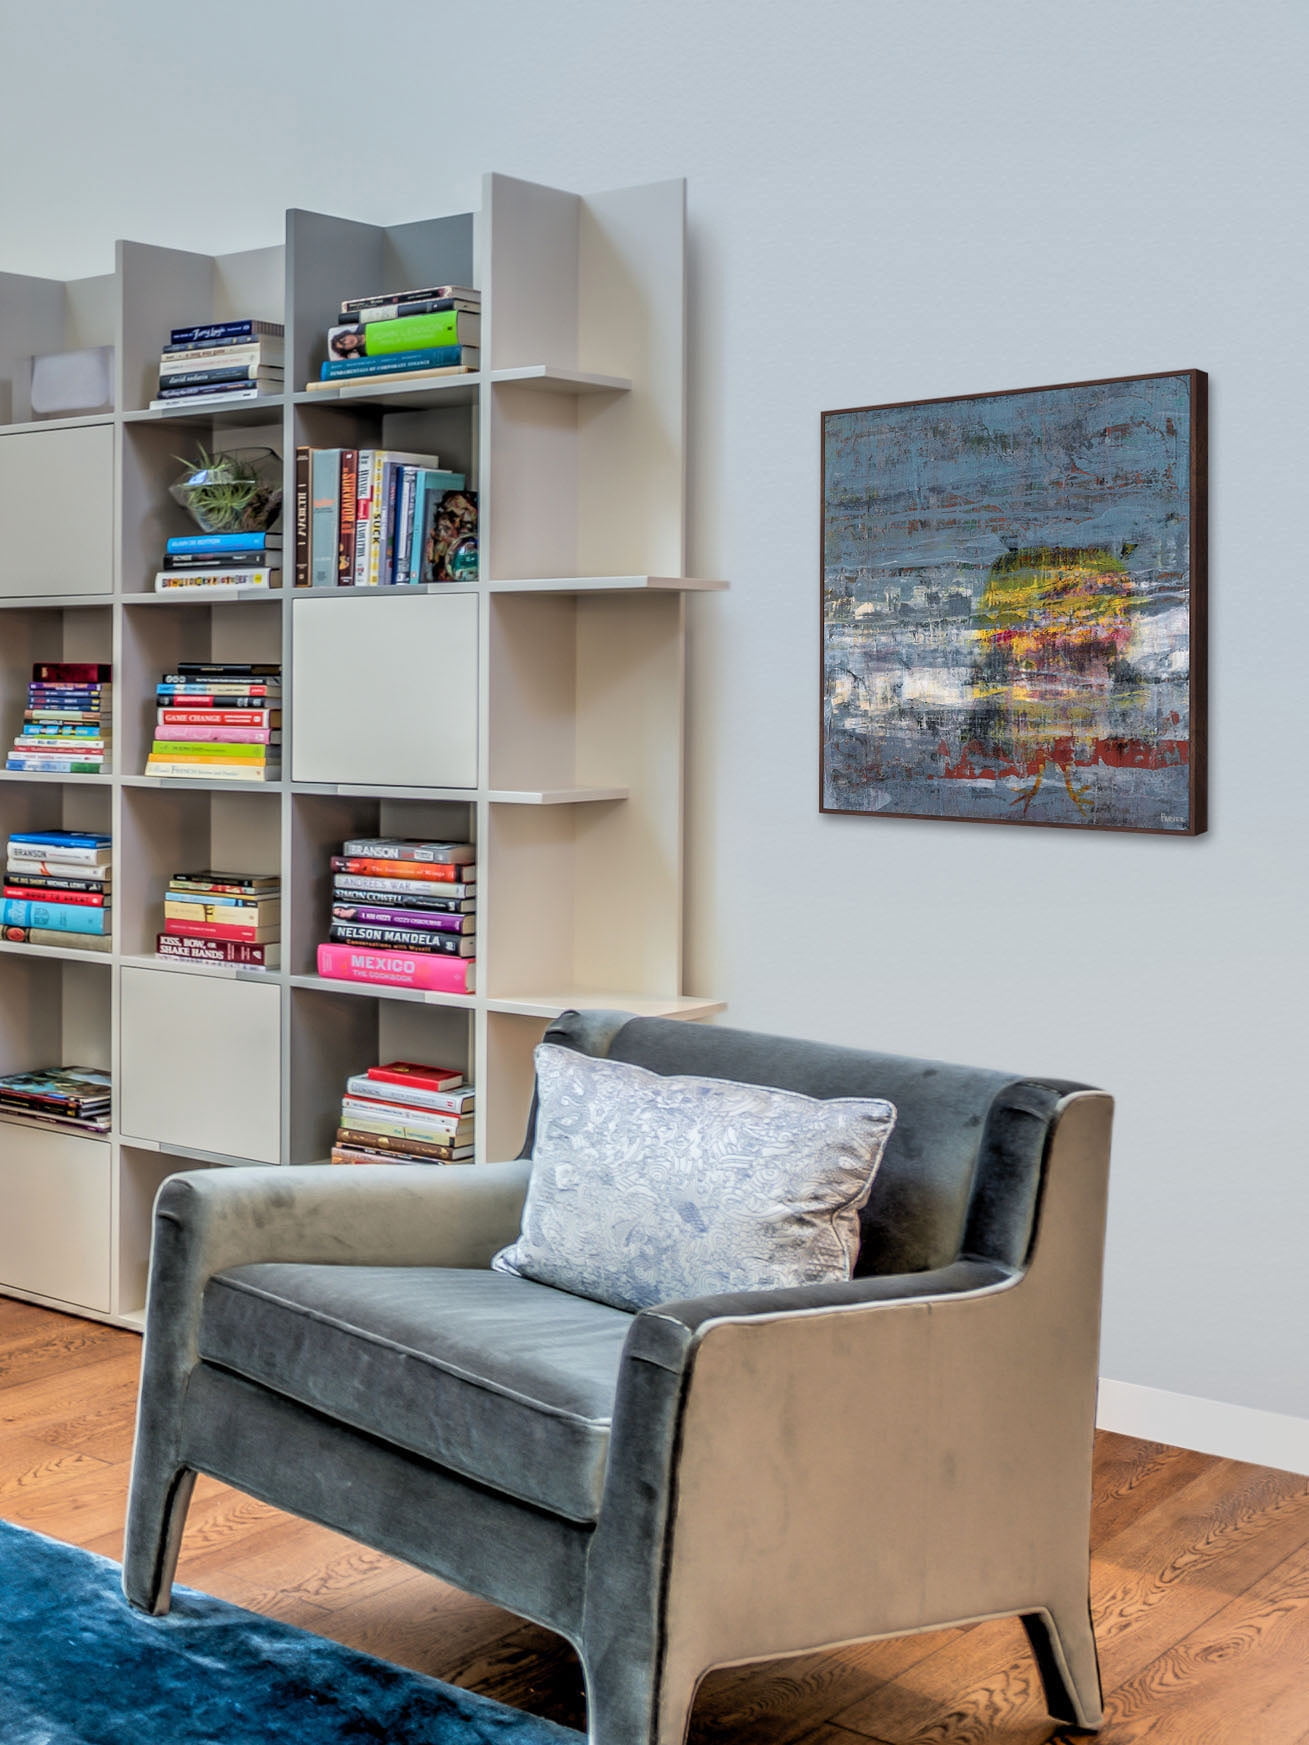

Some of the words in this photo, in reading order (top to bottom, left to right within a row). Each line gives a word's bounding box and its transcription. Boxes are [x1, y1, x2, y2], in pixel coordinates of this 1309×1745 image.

[359, 469, 369, 496] WINNING
[372, 513, 381, 544] SUCK
[357, 522, 367, 558] INNOVATION
[165, 714, 187, 722] GAME
[189, 714, 221, 722] CHANGE
[13, 847, 47, 859] BRANSON
[350, 845, 398, 859] BRANSON
[390, 880, 411, 891] WAR
[336, 890, 367, 901] SIMON
[367, 891, 404, 904] COWELL
[159, 936, 182, 947] KISS,
[337, 927, 382, 941] NELSON
[384, 931, 441, 946] MANDELA
[159, 945, 190, 957] SHAKE
[192, 948, 225, 960] HANDS
[351, 954, 416, 974] MEXICO
[353, 970, 369, 979] THE
